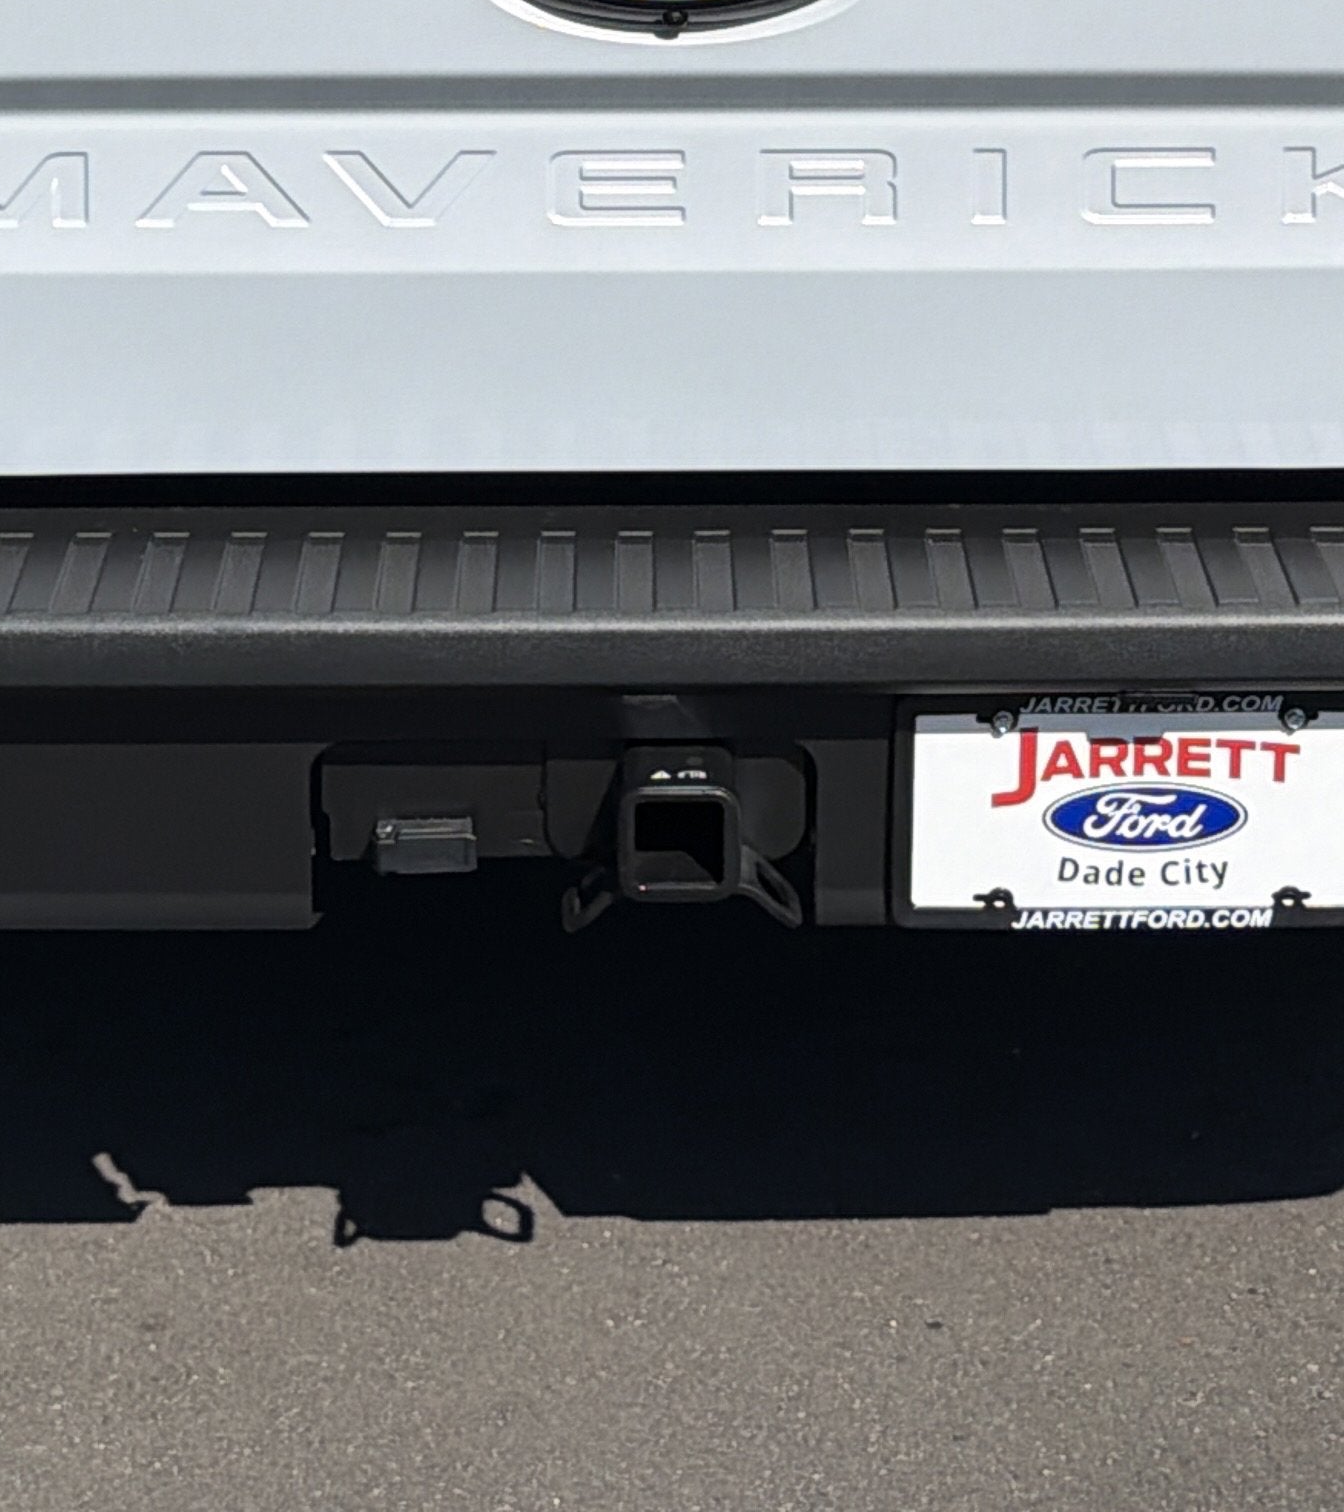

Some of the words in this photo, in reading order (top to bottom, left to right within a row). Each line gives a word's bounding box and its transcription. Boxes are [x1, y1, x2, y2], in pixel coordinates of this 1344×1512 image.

[991, 727, 1301, 807] JARRETT
[1083, 792, 1207, 839] Ford
[1057, 857, 1146, 886] Dade
[1160, 859, 1229, 889] City
[1011, 908, 1274, 930] JARRETTFORD.COM
